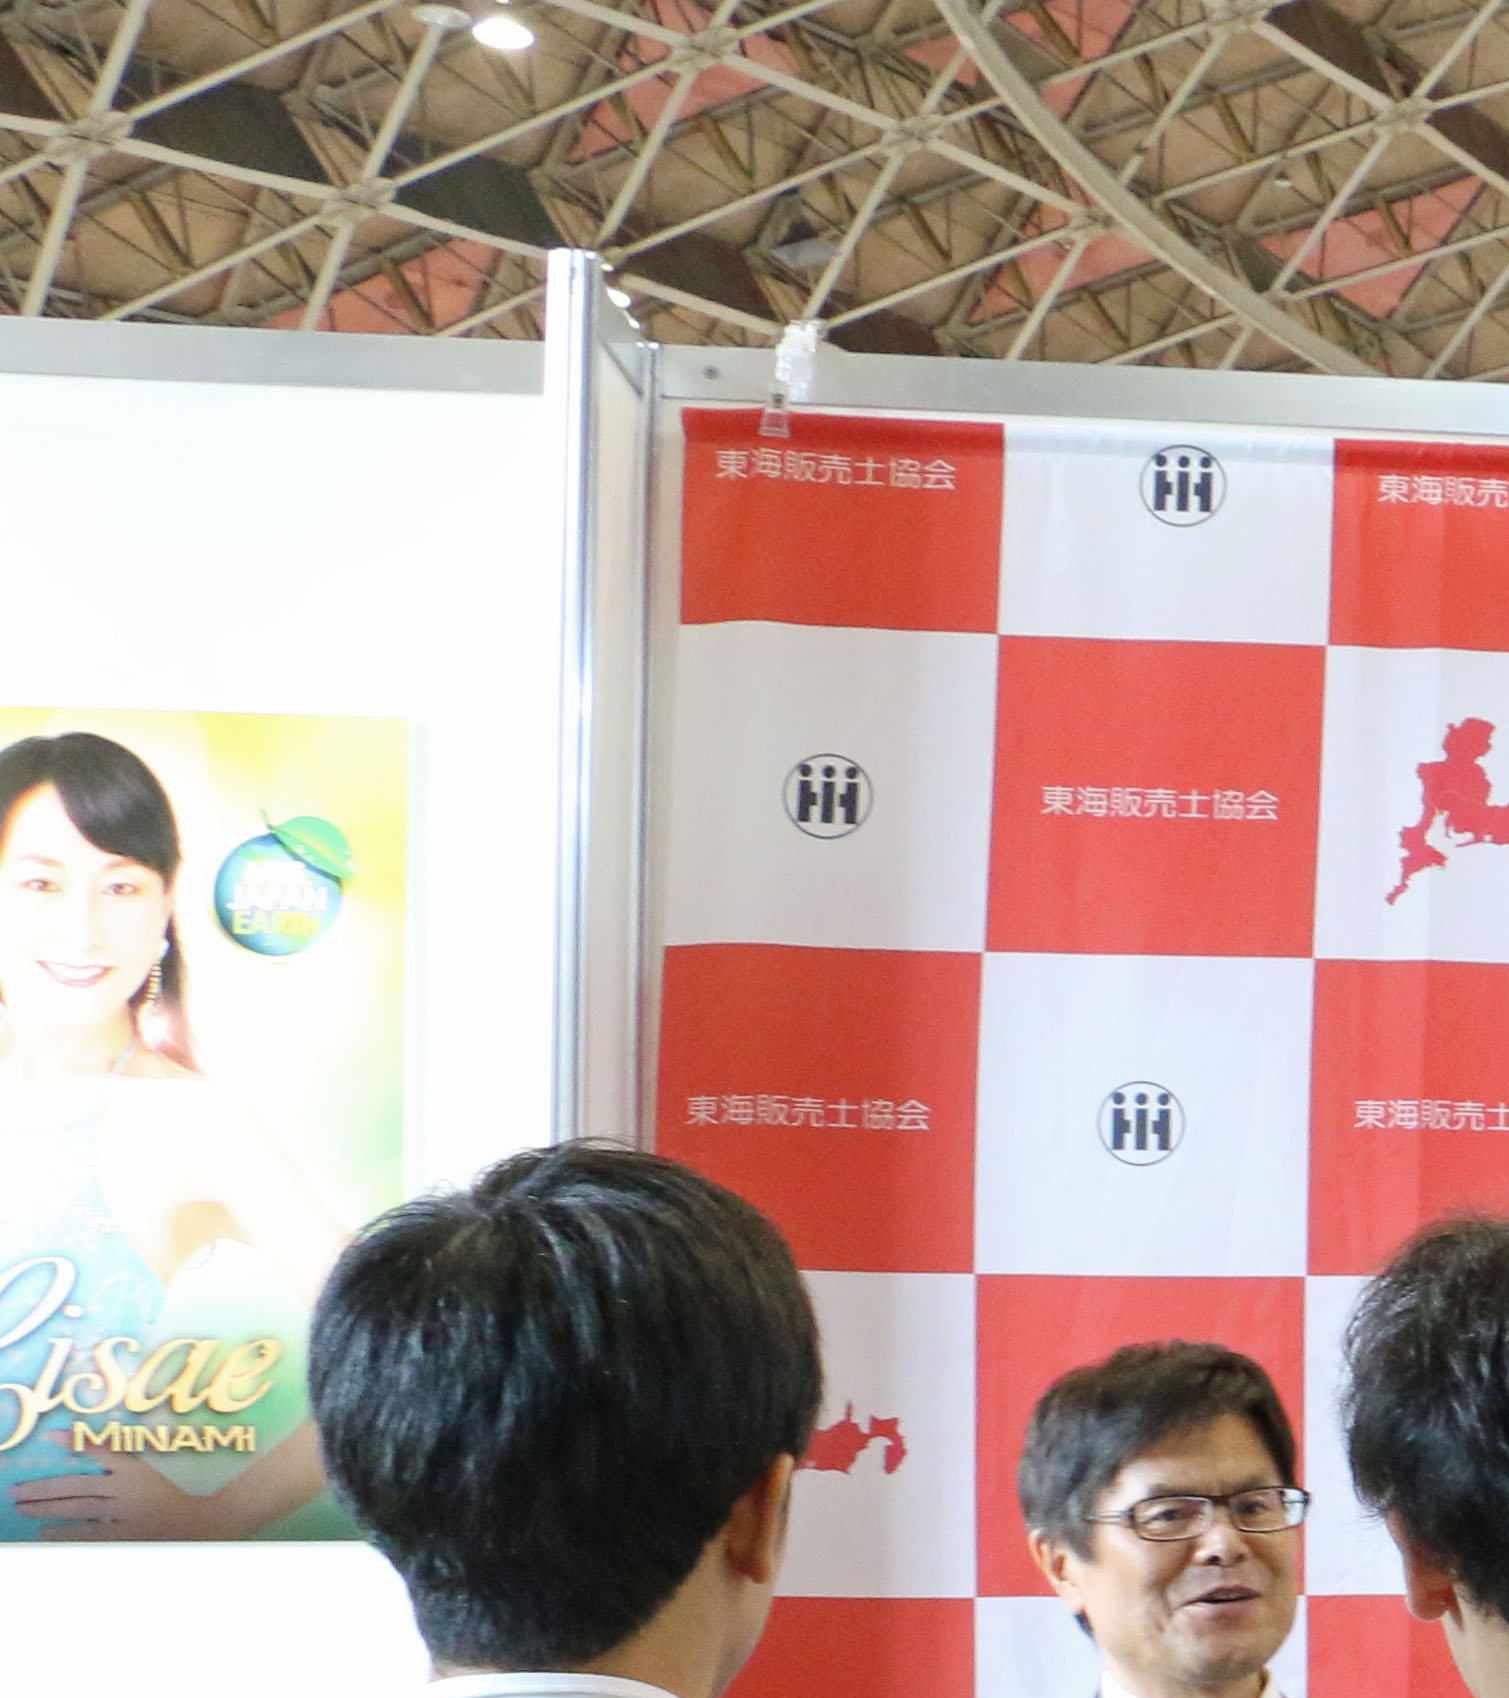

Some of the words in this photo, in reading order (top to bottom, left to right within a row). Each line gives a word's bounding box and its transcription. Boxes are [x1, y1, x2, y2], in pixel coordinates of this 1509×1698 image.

[714, 446, 958, 491] 東海販売士協会
[1040, 785, 1280, 822] 東海販売士協会
[685, 1093, 932, 1132] 東海販売士協会
[72, 1420, 256, 1452] MINAMI
